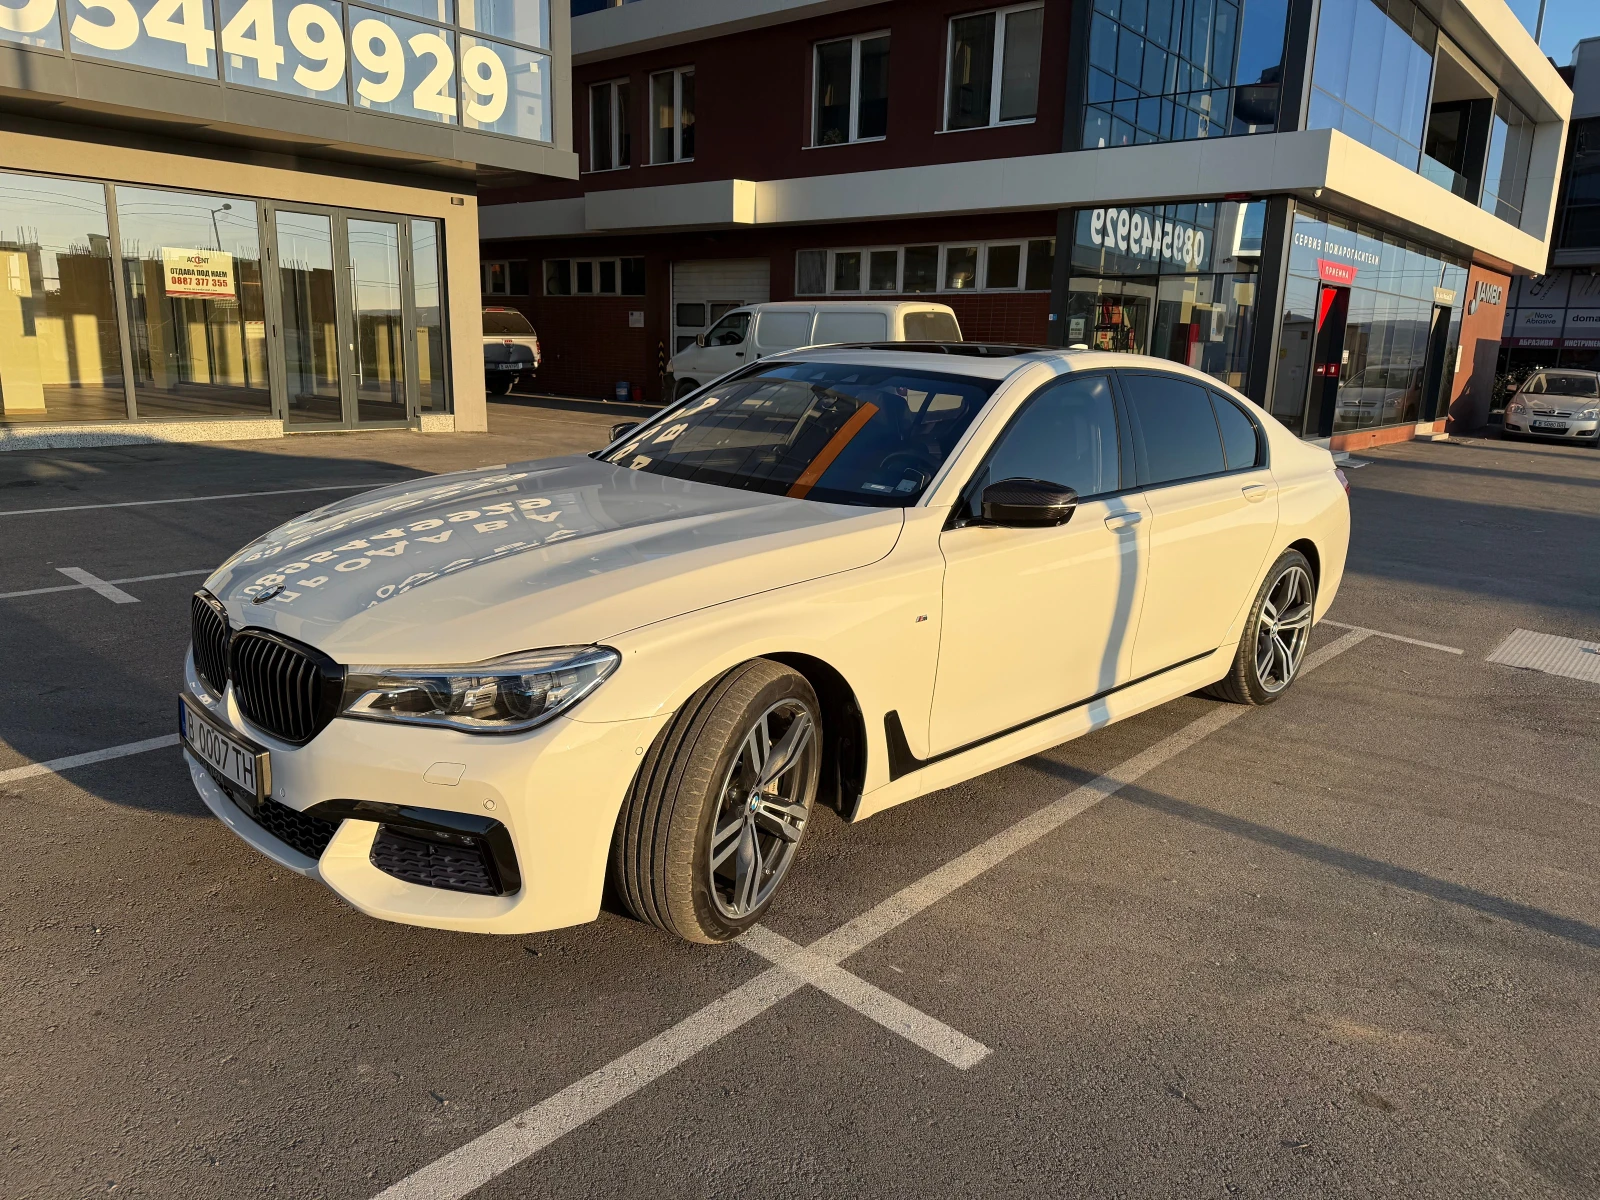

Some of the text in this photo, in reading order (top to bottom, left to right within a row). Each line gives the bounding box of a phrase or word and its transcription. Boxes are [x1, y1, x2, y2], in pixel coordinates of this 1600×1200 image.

[1294, 232, 1380, 265] СЕРВИЗ ПОЖАРОГАСИТЕЛИ
[170, 268, 228, 278] ОТДАВА ПОД НАЕМ
[1325, 266, 1349, 279] ПРИЕМНА
[171, 276, 228, 287] 0887 377 355
[1518, 338, 1554, 346] АБРАЗИВИ
[187, 711, 255, 790] B 0007 TH
